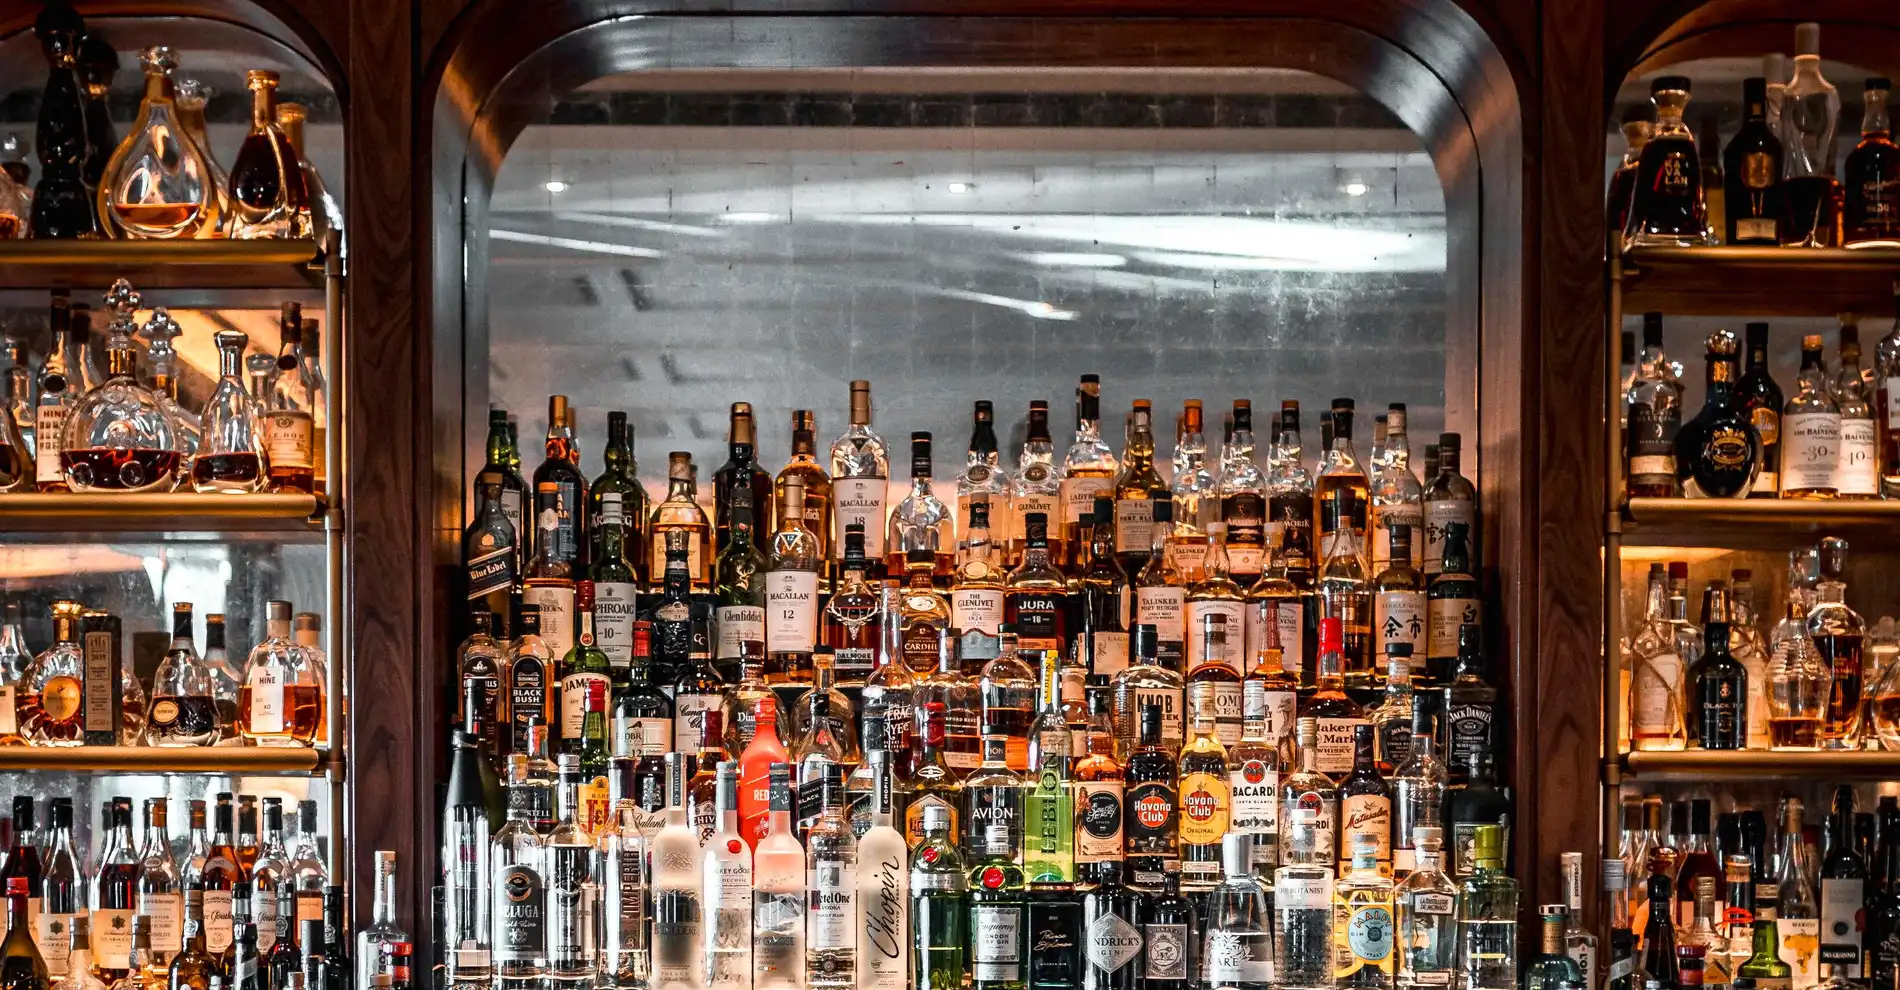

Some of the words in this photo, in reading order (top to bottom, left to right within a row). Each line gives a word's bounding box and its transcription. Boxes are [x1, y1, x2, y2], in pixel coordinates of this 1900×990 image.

[1664, 176, 1688, 184] LAN
[854, 516, 866, 526] 18
[469, 567, 487, 580] Blue
[487, 561, 506, 575] Label
[595, 604, 634, 614] PHROAIG
[958, 600, 994, 608] GLENLIVET
[1018, 600, 1054, 610] JURA
[724, 610, 762, 622] Glenfiddich
[783, 610, 794, 619] 12
[1032, 616, 1042, 624] 18
[1382, 614, 1424, 639] 余市
[604, 628, 614, 638] 10
[564, 678, 610, 692] JAMN
[1137, 694, 1172, 713] KNOB
[884, 707, 912, 722] ZERAC
[1449, 709, 1466, 724] JACK
[1466, 707, 1492, 724] DANIEL'S
[1316, 724, 1354, 732] aker'
[1323, 734, 1356, 744] Mark
[632, 749, 642, 757] 12
[990, 747, 1004, 755] ION
[754, 789, 769, 801] RED
[1232, 784, 1276, 797] BACARDÍ
[798, 794, 820, 805] BLACK
[1040, 751, 1058, 854] LEBLON
[1184, 795, 1220, 806] Havana
[1134, 801, 1172, 812] Havana
[1189, 806, 1212, 816] Club
[972, 808, 1013, 819] AVION
[1142, 812, 1164, 822] Club
[634, 814, 667, 828] Ballanti
[694, 815, 716, 826] CHIV
[1149, 836, 1157, 848] 7
[834, 892, 850, 904] One
[504, 905, 539, 918] ELUGA
[866, 856, 904, 958] Chopin
[1082, 936, 1140, 946] HNDRICK'S
[1218, 958, 1239, 967] ARE
